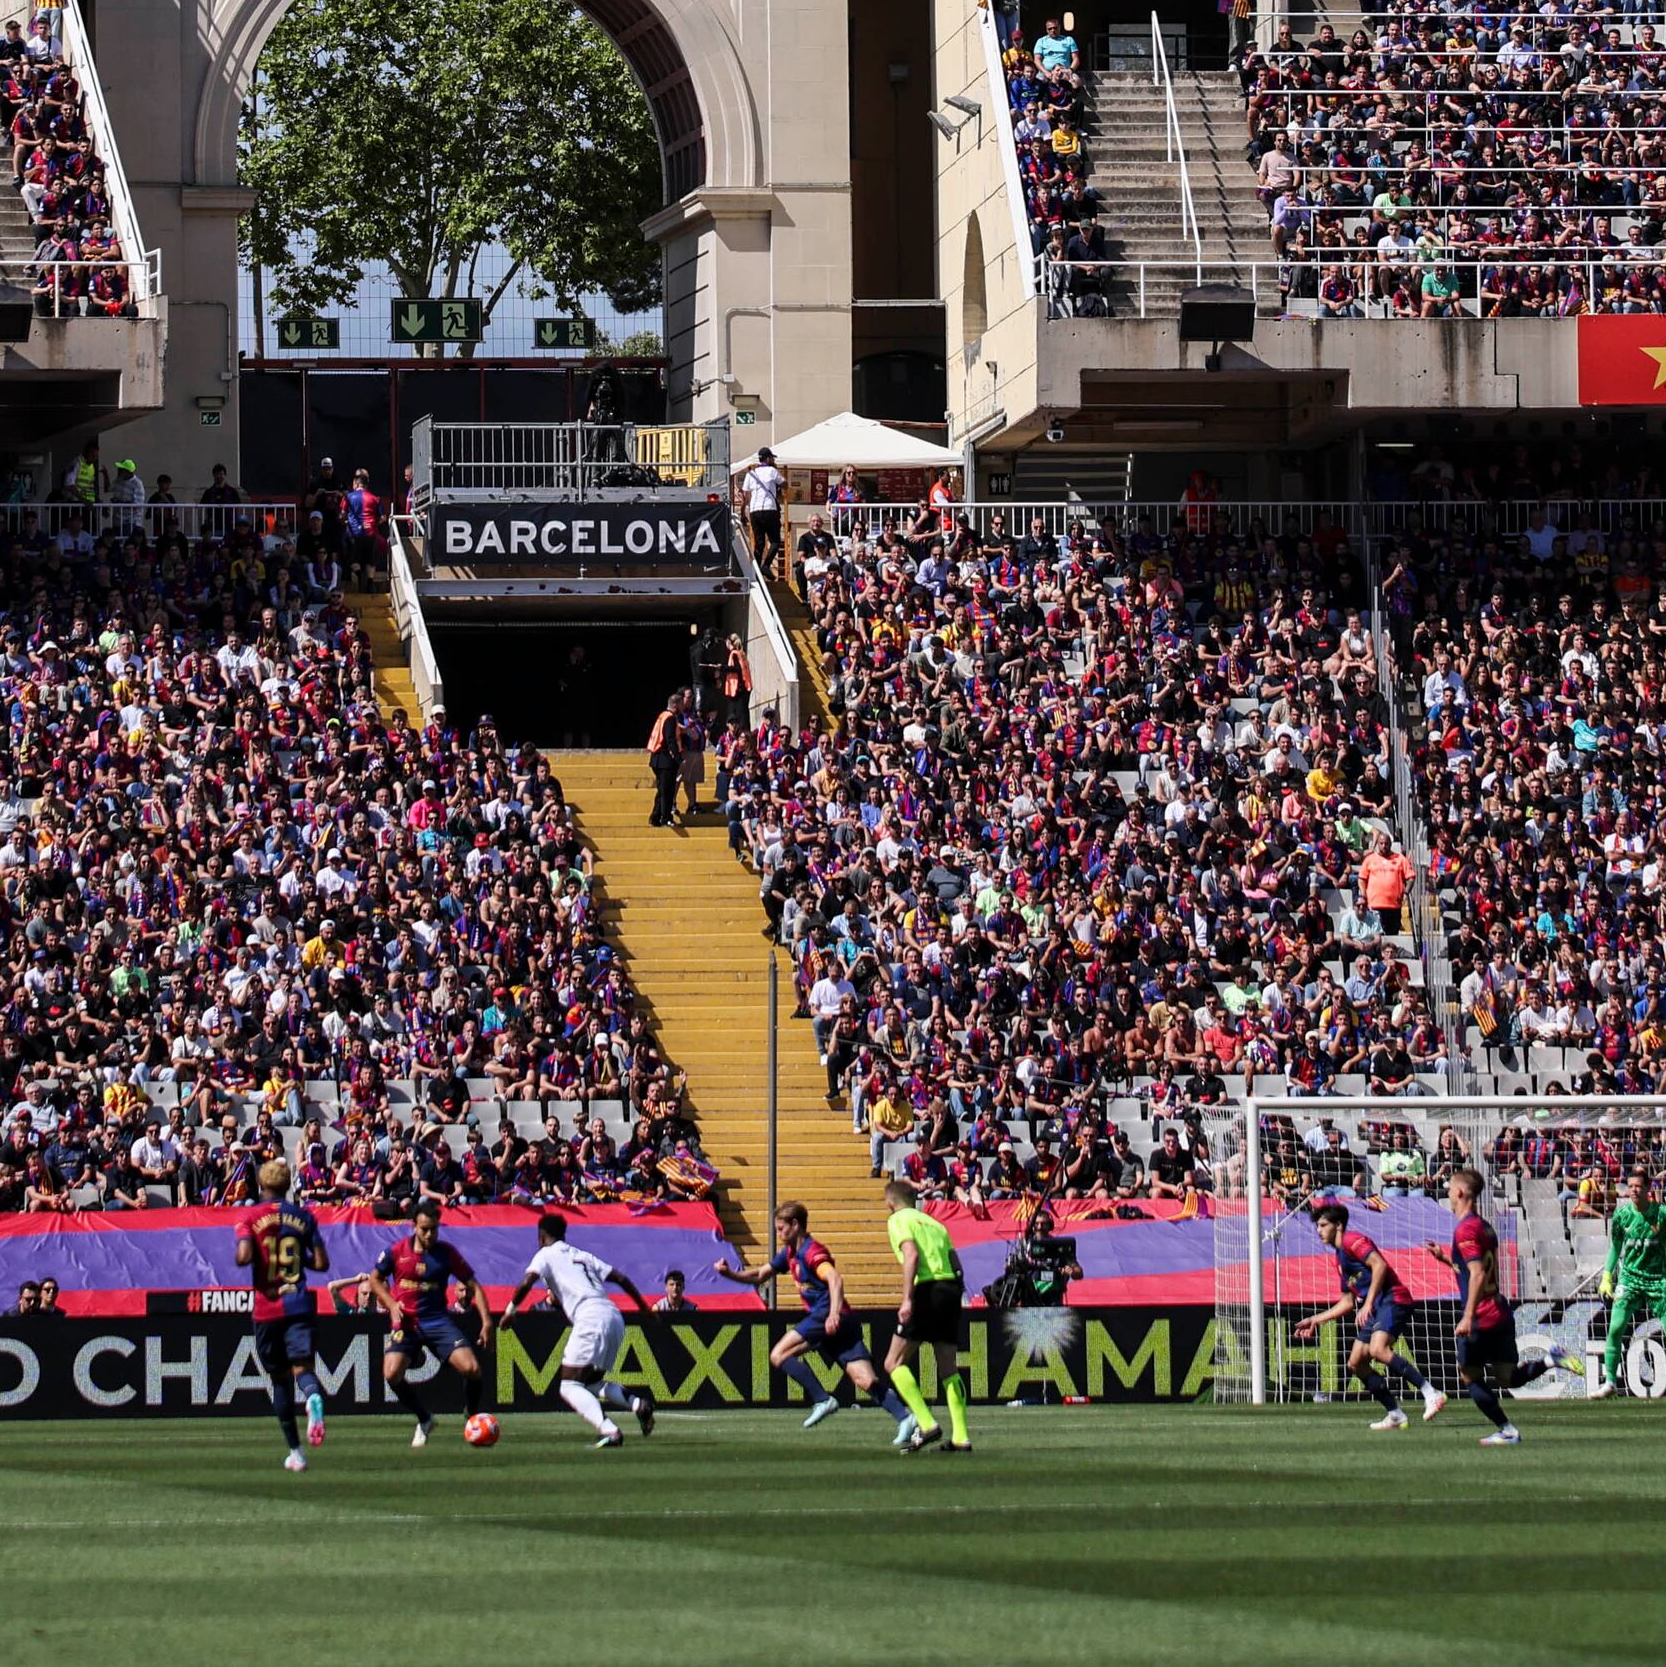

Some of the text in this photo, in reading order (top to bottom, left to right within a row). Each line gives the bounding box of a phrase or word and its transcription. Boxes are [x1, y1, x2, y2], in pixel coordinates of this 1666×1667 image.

[446, 519, 721, 555] BARCELONA
[261, 1236, 301, 1284] 19
[573, 1259, 597, 1289] 7
